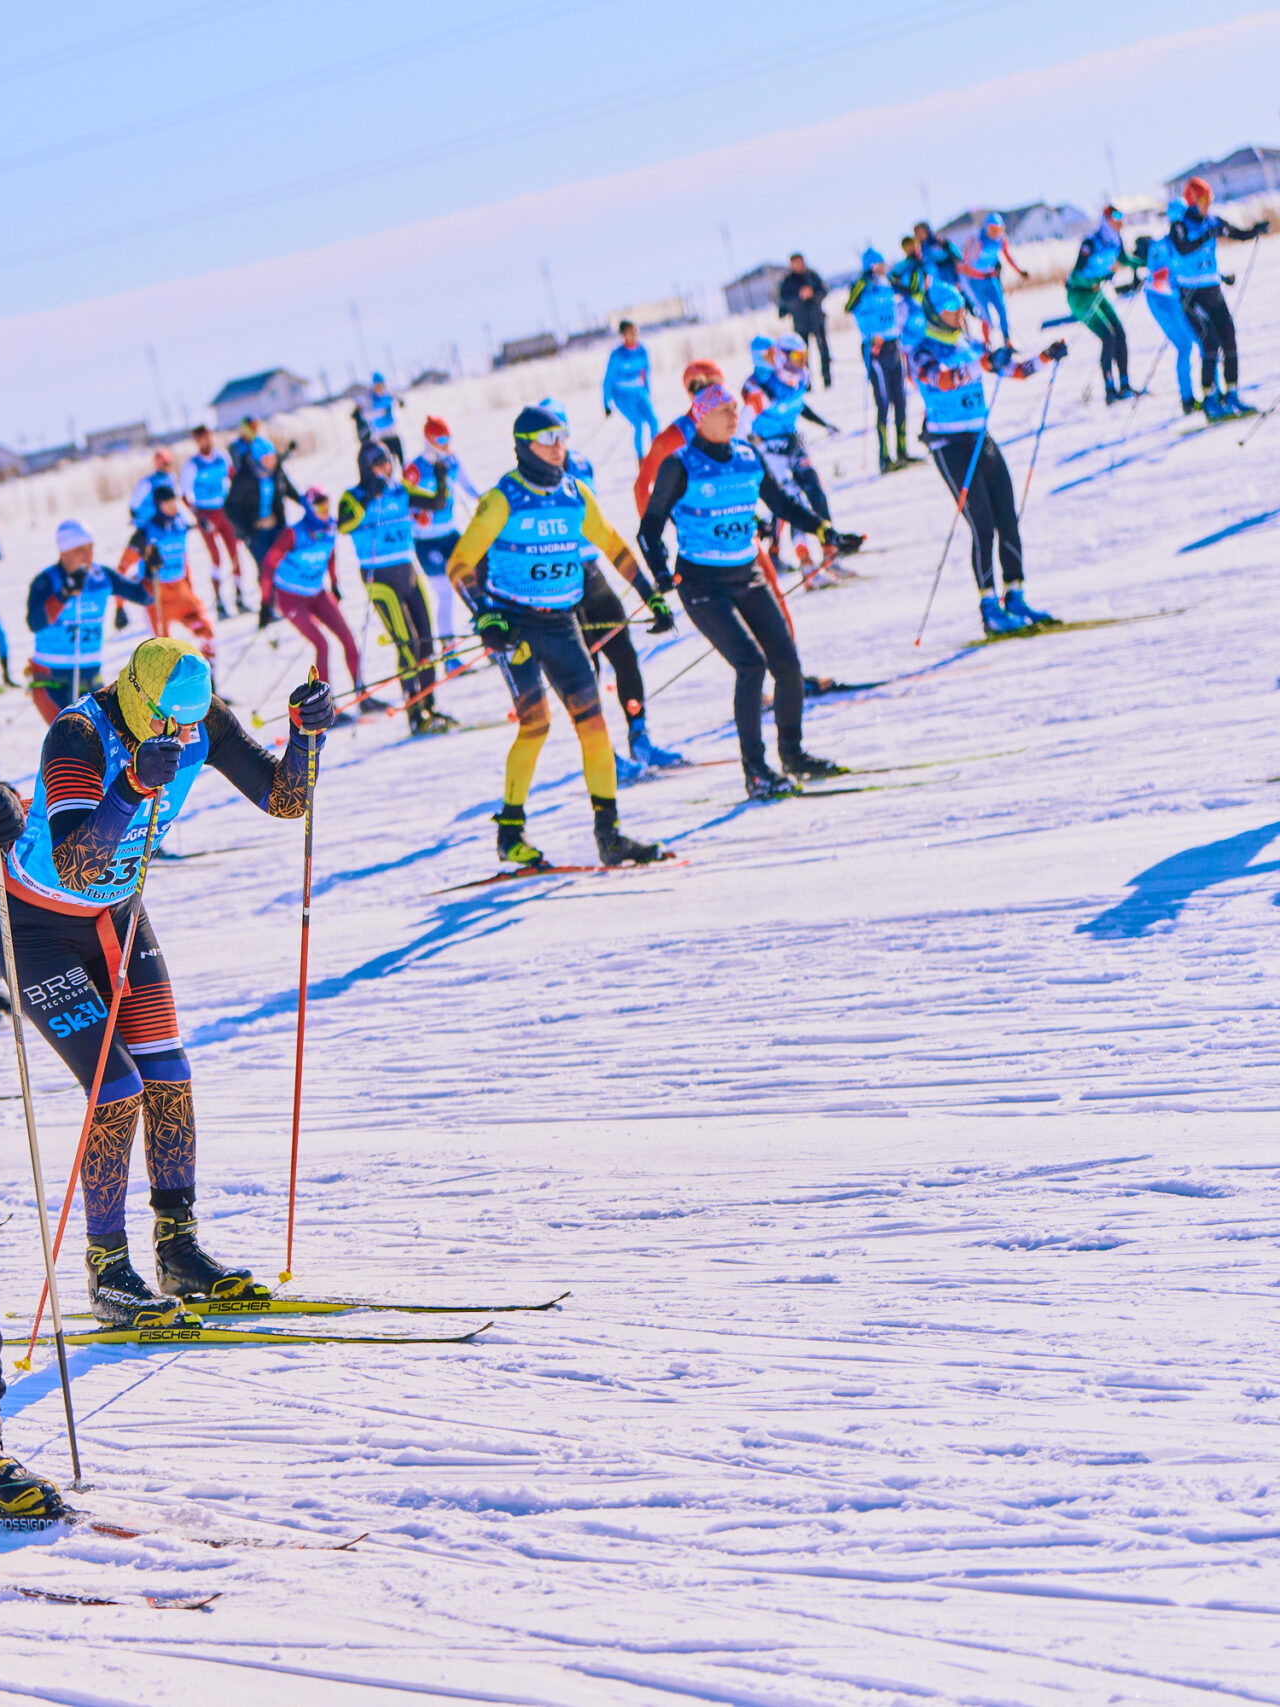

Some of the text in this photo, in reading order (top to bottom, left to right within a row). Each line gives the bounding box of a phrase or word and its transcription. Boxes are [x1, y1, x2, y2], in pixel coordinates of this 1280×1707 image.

[537, 518, 569, 537] ВТБ
[308, 749, 316, 787] LEKI
[208, 1302, 270, 1313] FISCHER
[139, 1330, 201, 1341] FISCHER
